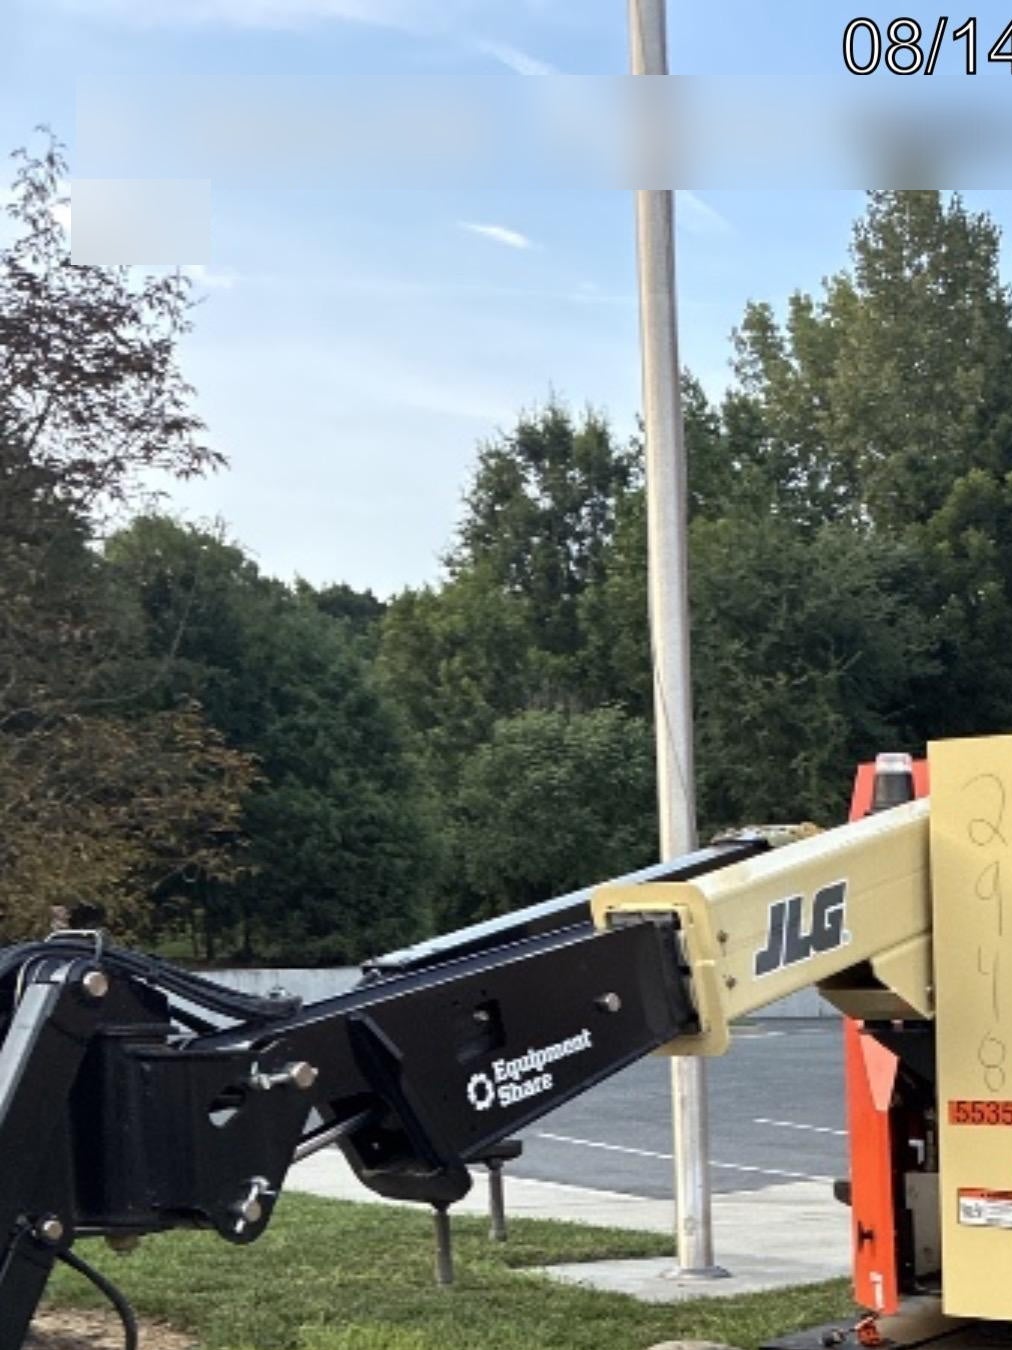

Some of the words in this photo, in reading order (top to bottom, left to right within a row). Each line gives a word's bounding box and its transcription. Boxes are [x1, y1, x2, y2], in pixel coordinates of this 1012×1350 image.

[754, 879, 848, 978] JLG
[490, 1028, 592, 1083] Equipment
[497, 1072, 553, 1108] Share
